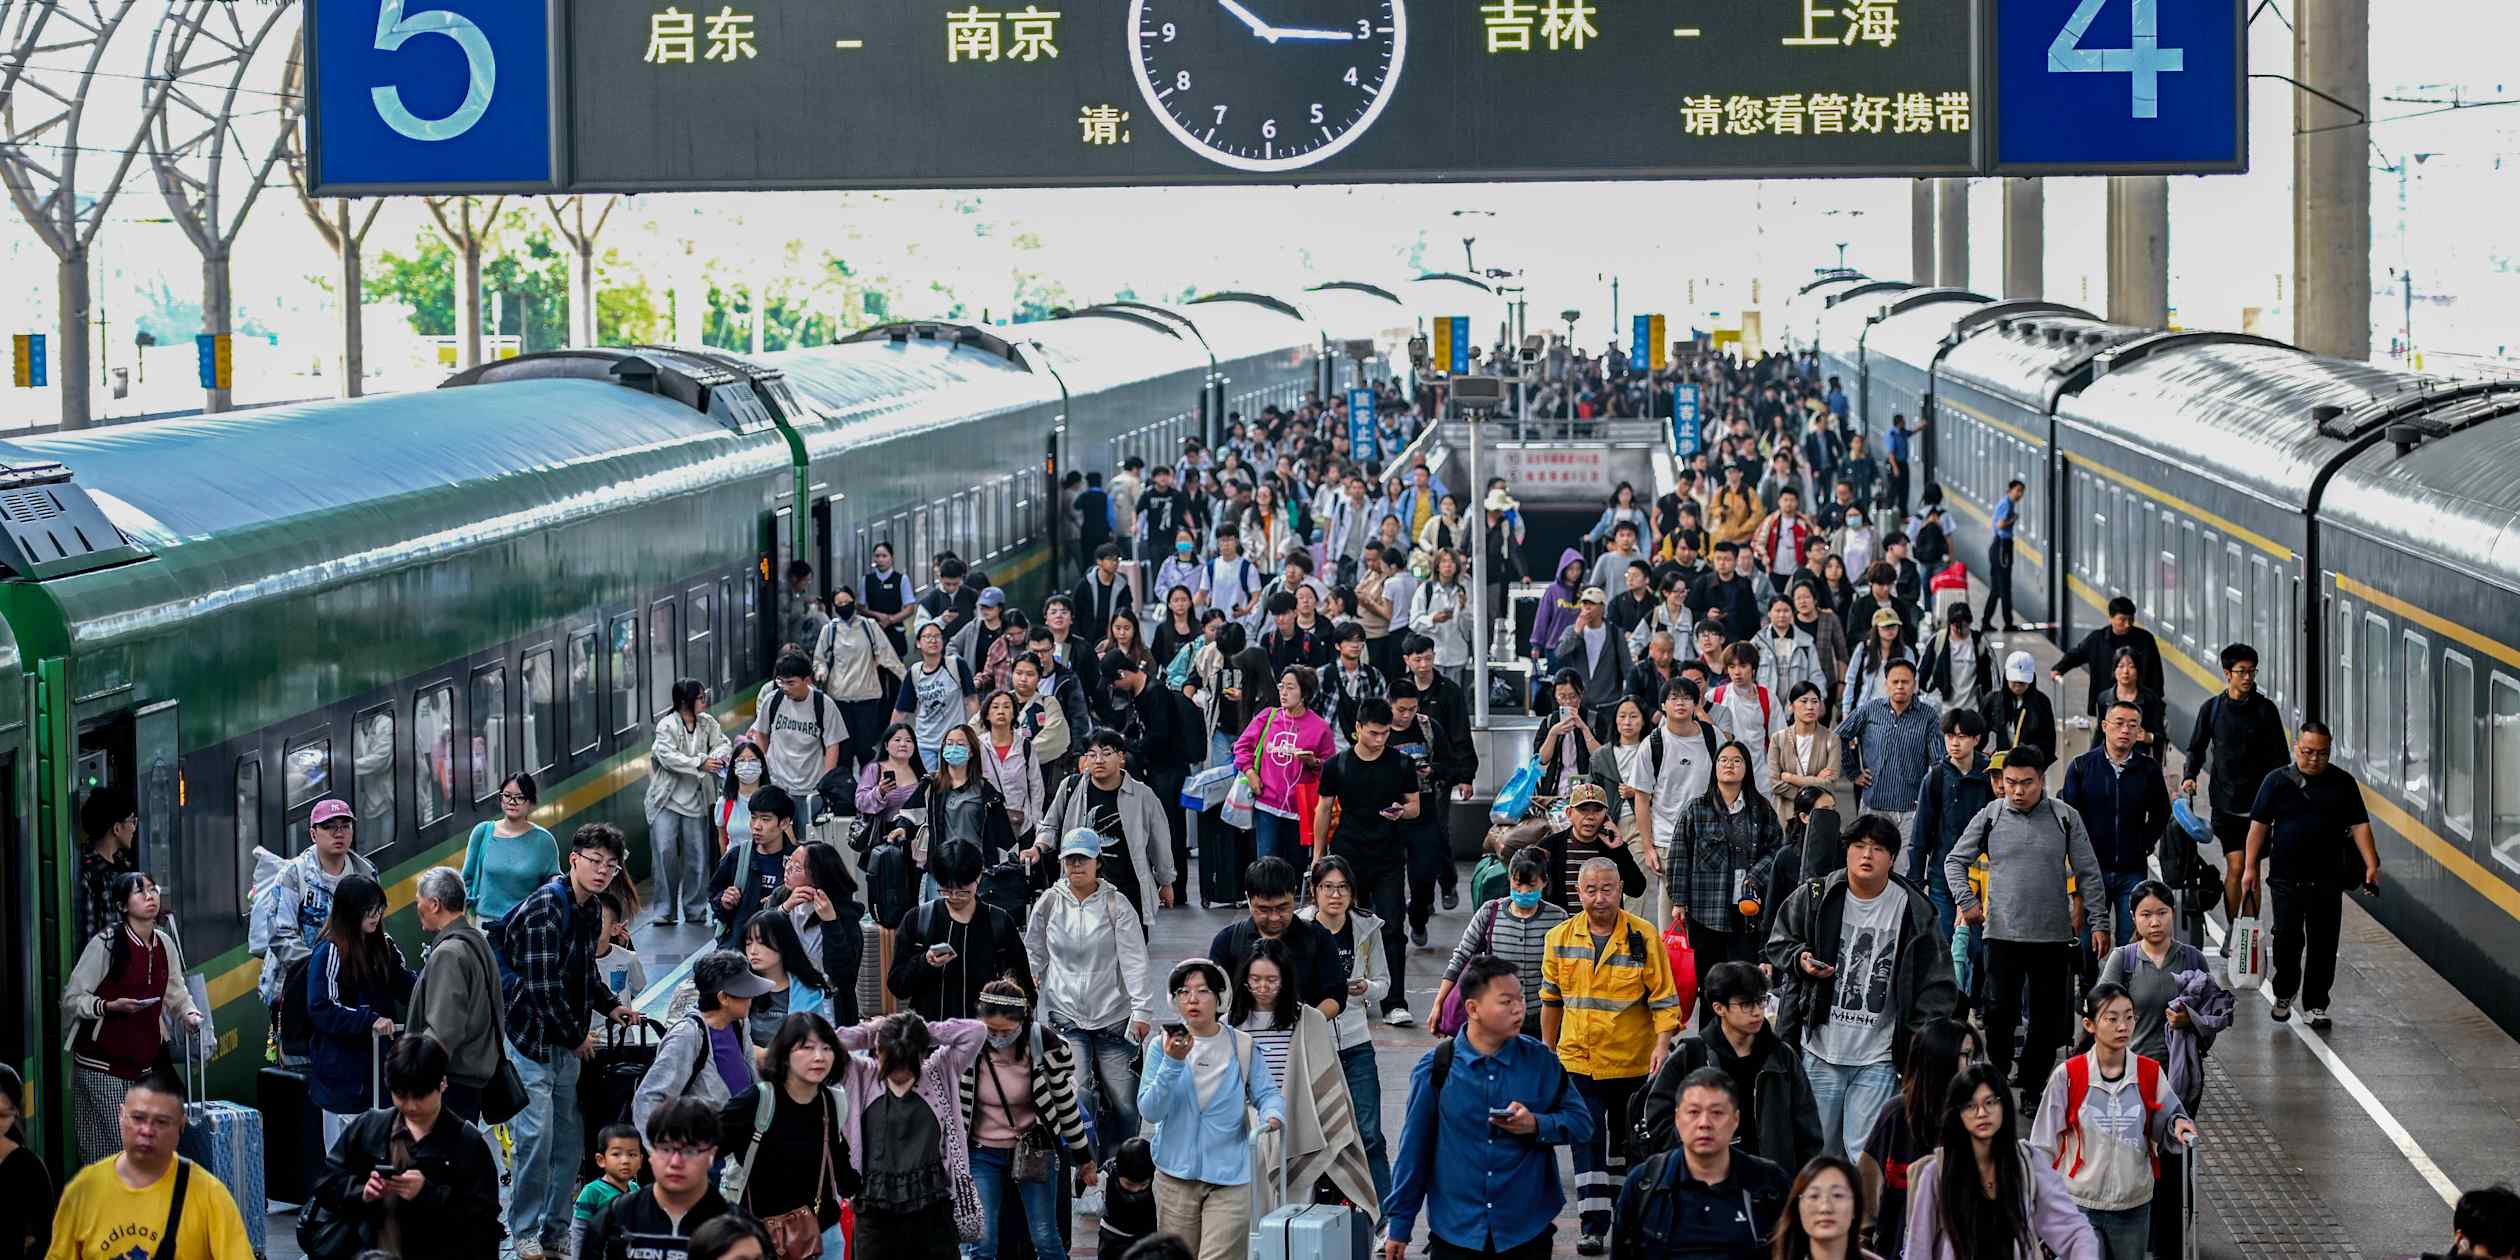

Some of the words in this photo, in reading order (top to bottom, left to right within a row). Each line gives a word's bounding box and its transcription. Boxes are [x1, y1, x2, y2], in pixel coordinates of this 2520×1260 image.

[643, 6, 758, 64] 启东
[946, 6, 1061, 63] 南京
[1162, 23, 1176, 43] 9
[1357, 20, 1371, 39] 3
[1480, 0, 1599, 53] 吉林
[1782, 0, 1900, 48] 上海
[371, 0, 495, 141] 5
[2047, 0, 2184, 119] 4
[1177, 71, 1191, 91] 8
[1344, 67, 1359, 86] 4
[1078, 104, 1131, 145] 请
[1213, 105, 1228, 124] 7
[1310, 104, 1325, 124] 5
[1680, 92, 1970, 136] 请您看管好携带
[1262, 119, 1277, 139] 6
[100, 1222, 158, 1251] adidas
